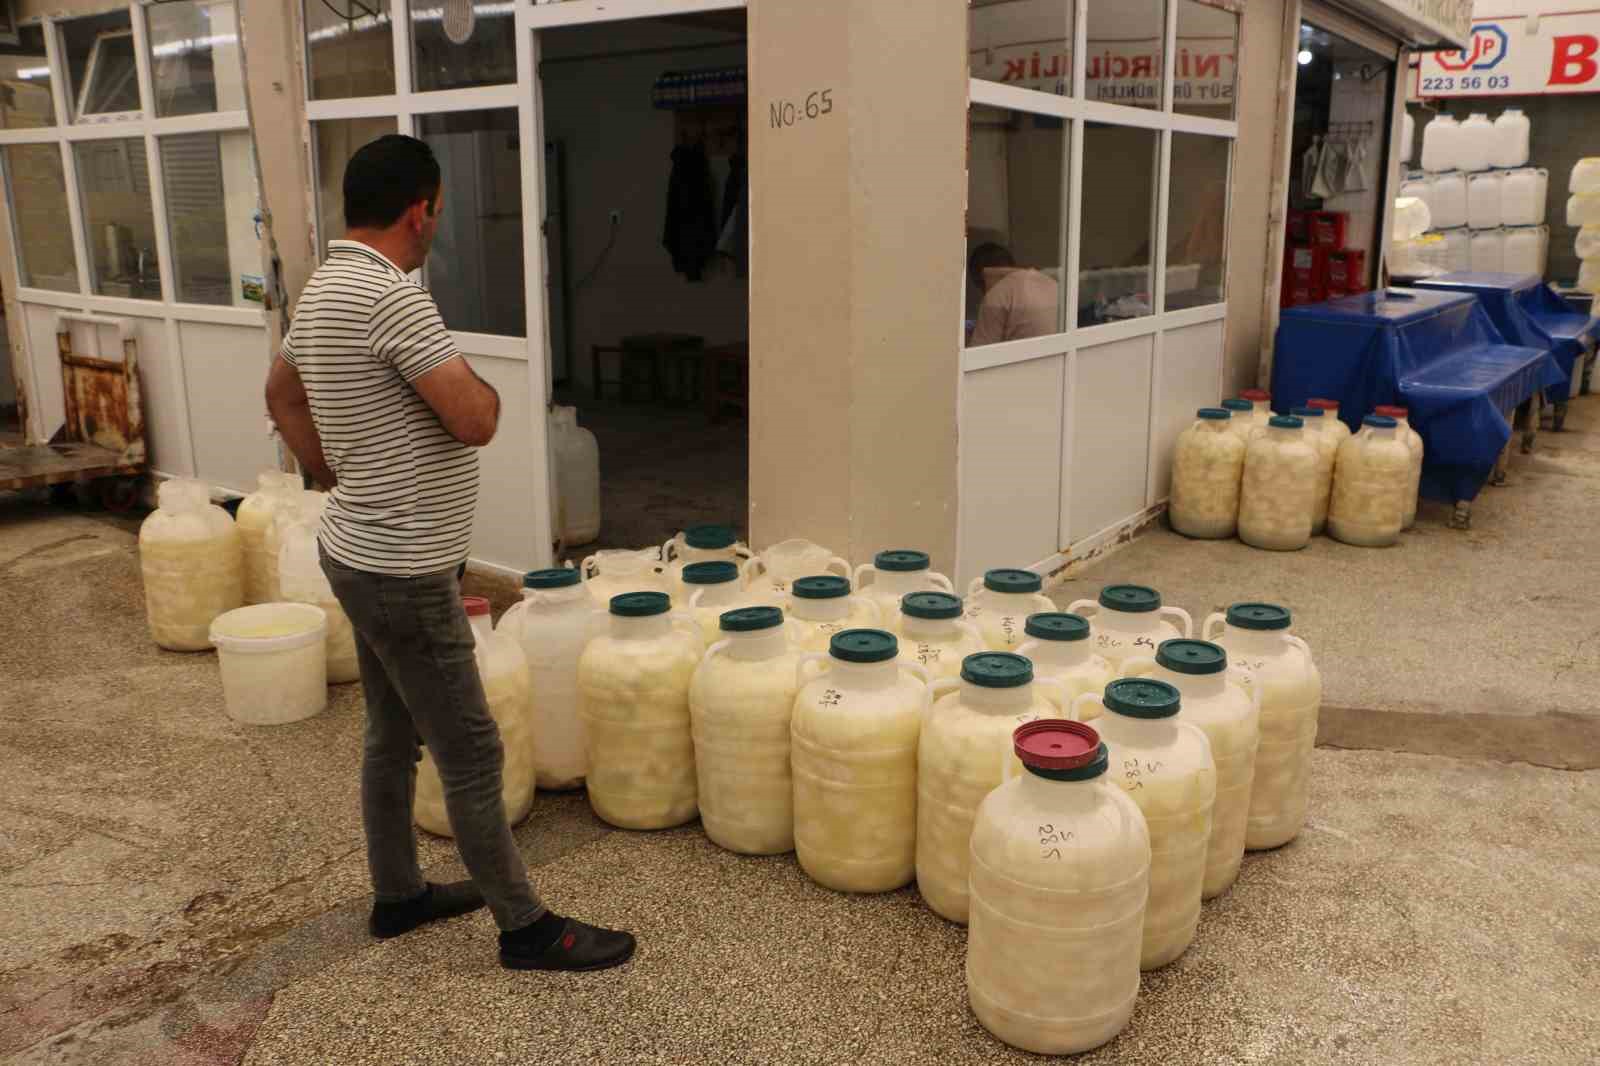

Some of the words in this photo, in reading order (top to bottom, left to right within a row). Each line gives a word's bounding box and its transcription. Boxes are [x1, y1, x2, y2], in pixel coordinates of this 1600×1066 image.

[1547, 34, 1598, 86] B
[1423, 77, 1454, 90] 223
[1460, 76, 1481, 89] 56
[1487, 75, 1509, 89] 03
